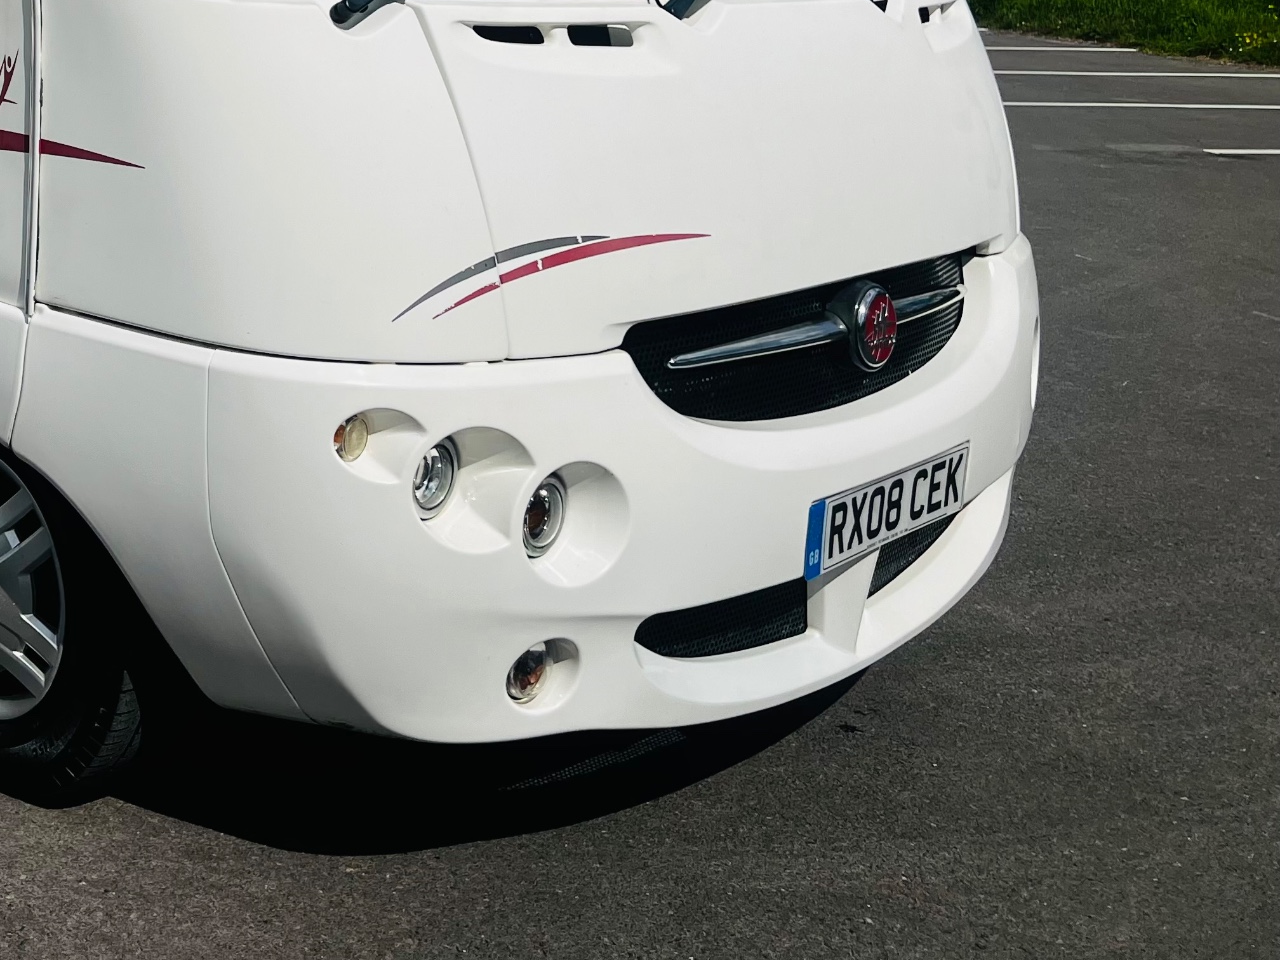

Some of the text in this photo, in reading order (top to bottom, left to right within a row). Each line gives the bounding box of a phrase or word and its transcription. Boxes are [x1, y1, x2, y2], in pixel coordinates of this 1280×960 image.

[828, 453, 964, 559] RX08 CEK
[809, 549, 819, 566] GB
